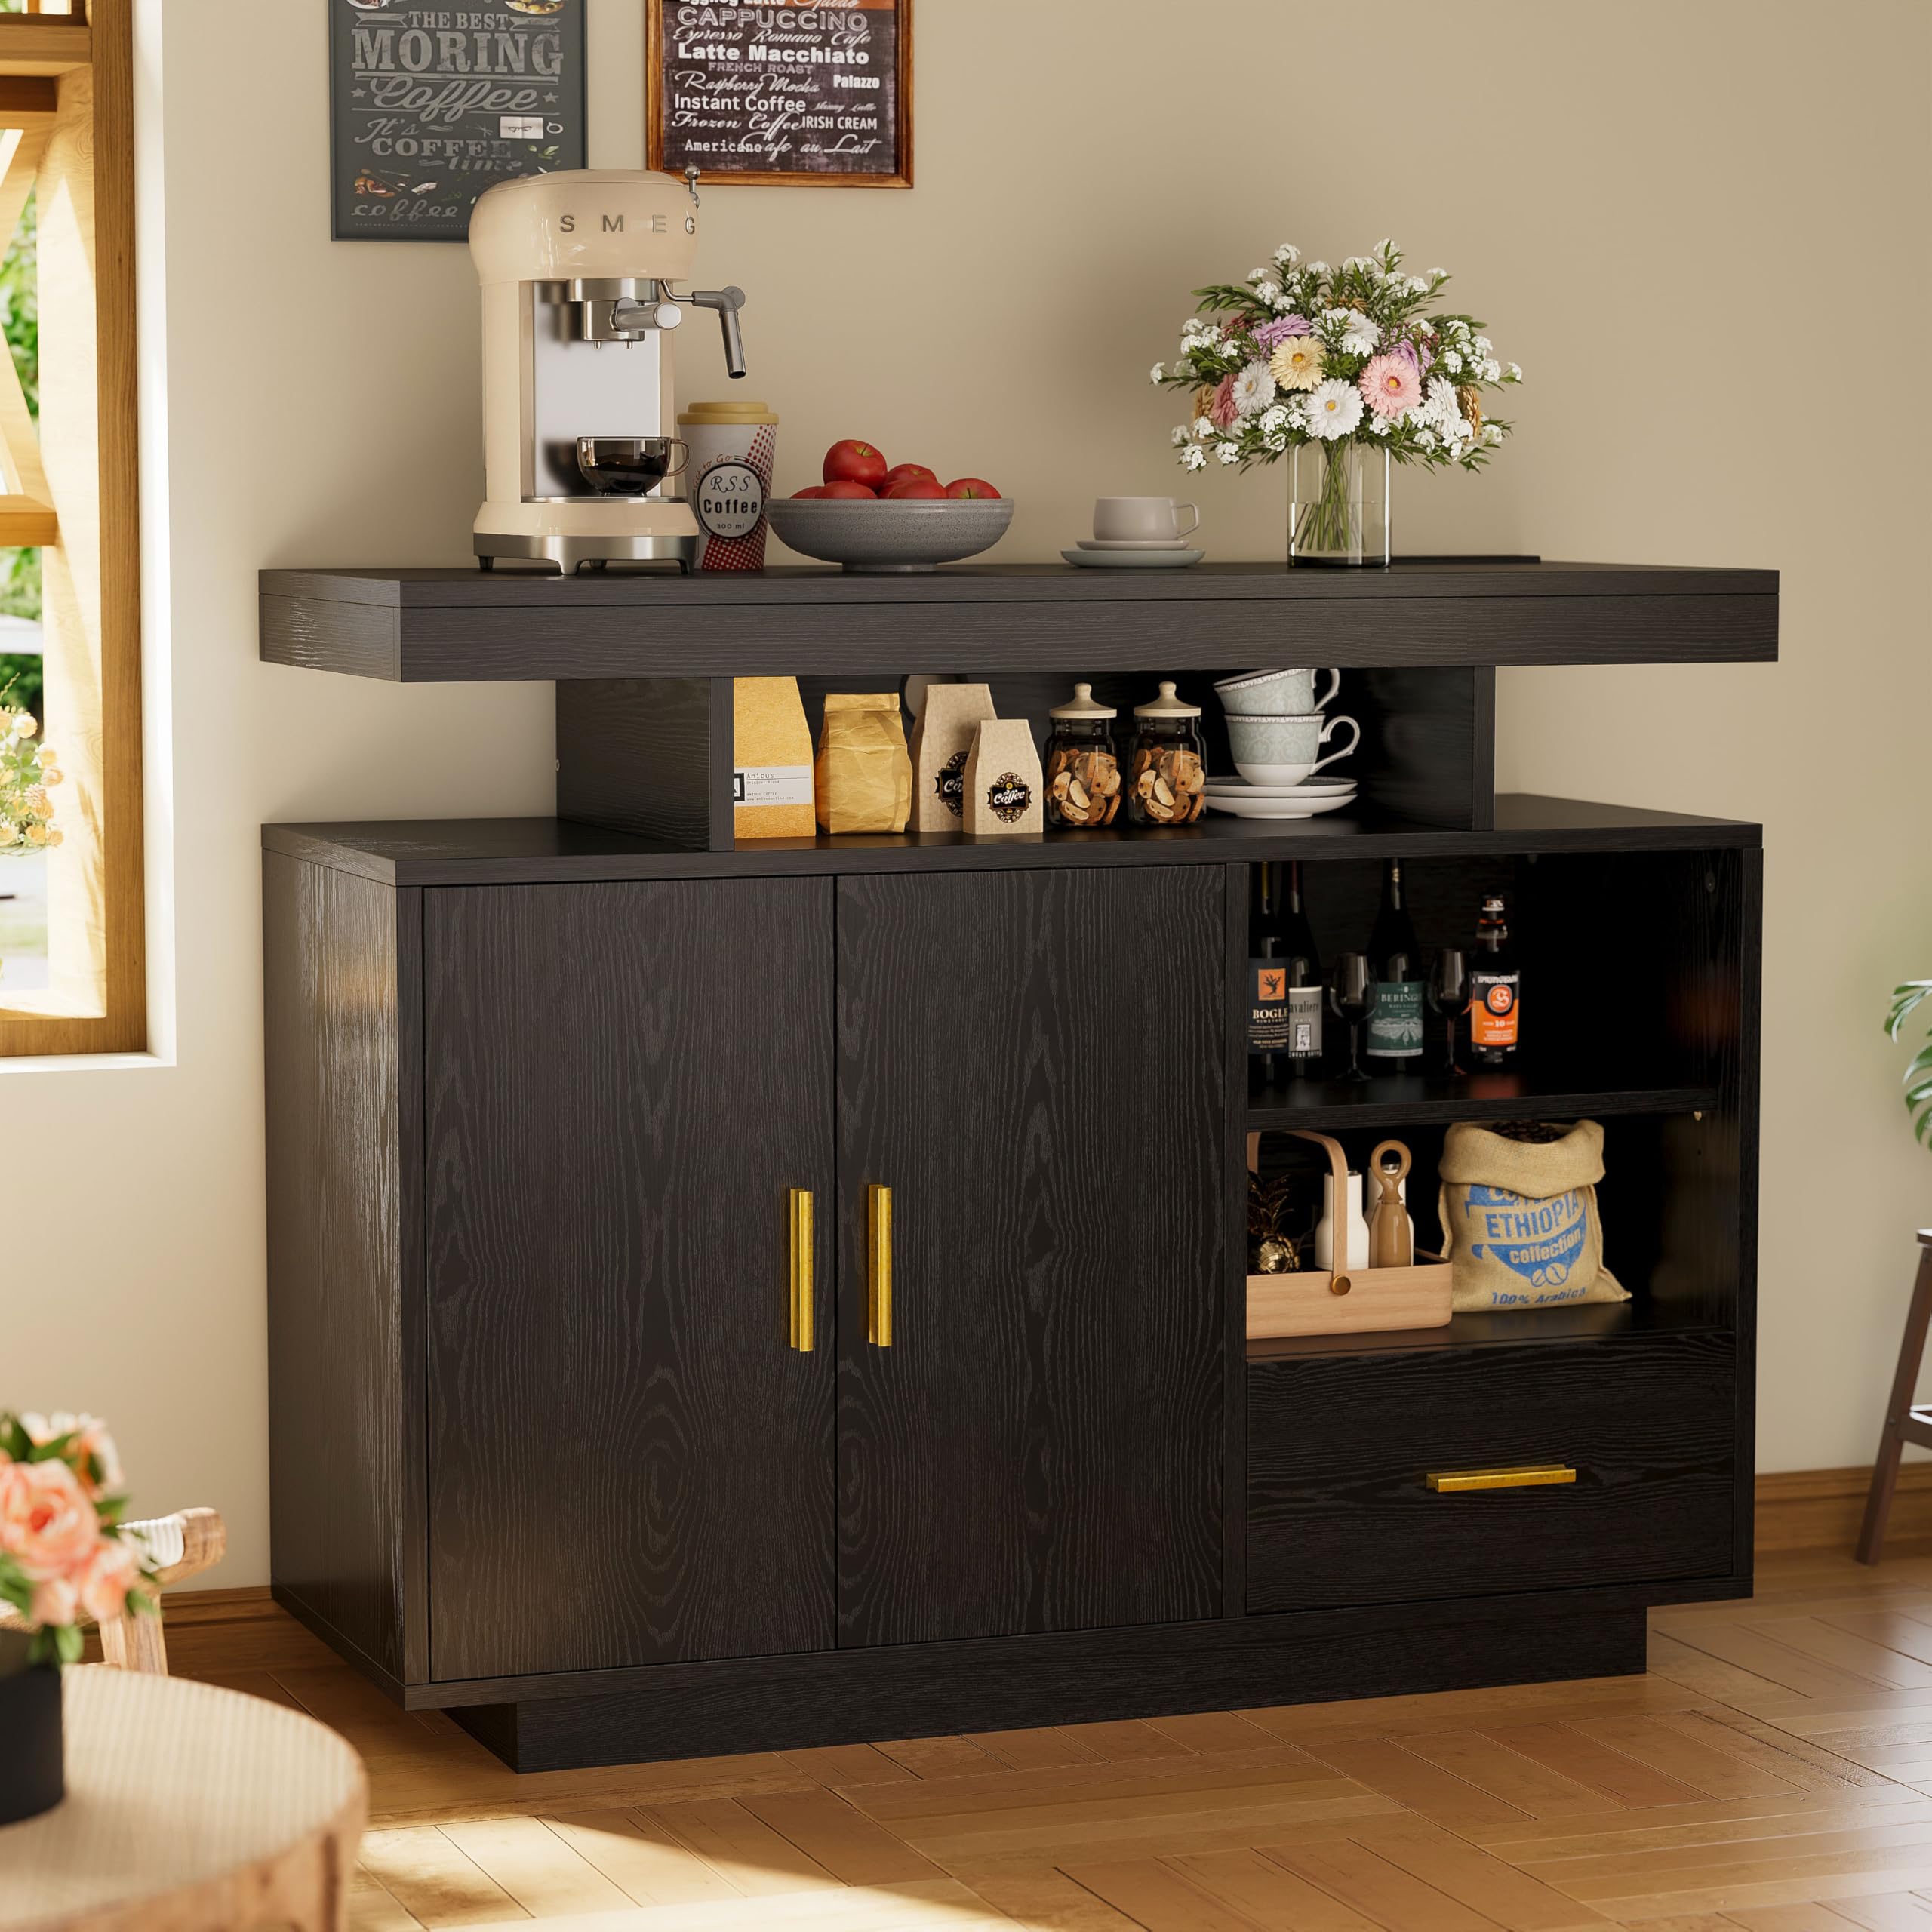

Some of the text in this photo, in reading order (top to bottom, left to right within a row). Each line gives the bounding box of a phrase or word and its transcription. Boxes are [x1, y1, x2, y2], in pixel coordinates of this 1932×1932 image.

[408, 11, 509, 30] THE BEST
[678, 6, 867, 31] CAPPUCCINO
[673, 26, 872, 49] Espresso Romano Cafe
[352, 29, 564, 75] MORING
[678, 42, 869, 65] Latte Macchiato
[708, 62, 814, 75] FRENCH ROAST
[675, 70, 820, 98] Raspberry Mocha
[833, 75, 880, 89] Palazzo
[370, 75, 538, 122] Coffee
[675, 93, 806, 112] Instant Coffee
[354, 118, 420, 143] It's
[672, 111, 804, 141] Frozen Coffee
[802, 115, 877, 130] IRISH CREAM
[372, 138, 512, 158] COFFEE
[685, 139, 762, 152] Americano
[800, 142, 821, 152] au
[823, 134, 882, 154] Lait
[351, 199, 458, 221] coffee
[716, 454, 733, 463] Go
[704, 499, 758, 514] Coffee
[993, 789, 1026, 805] Coffee
[1252, 1008, 1287, 1019] BOGLE
[1485, 1189, 1579, 1238] ETHIOPIA
[1510, 1228, 1581, 1264] collection
[1492, 1287, 1586, 1304] 100% Arabica
